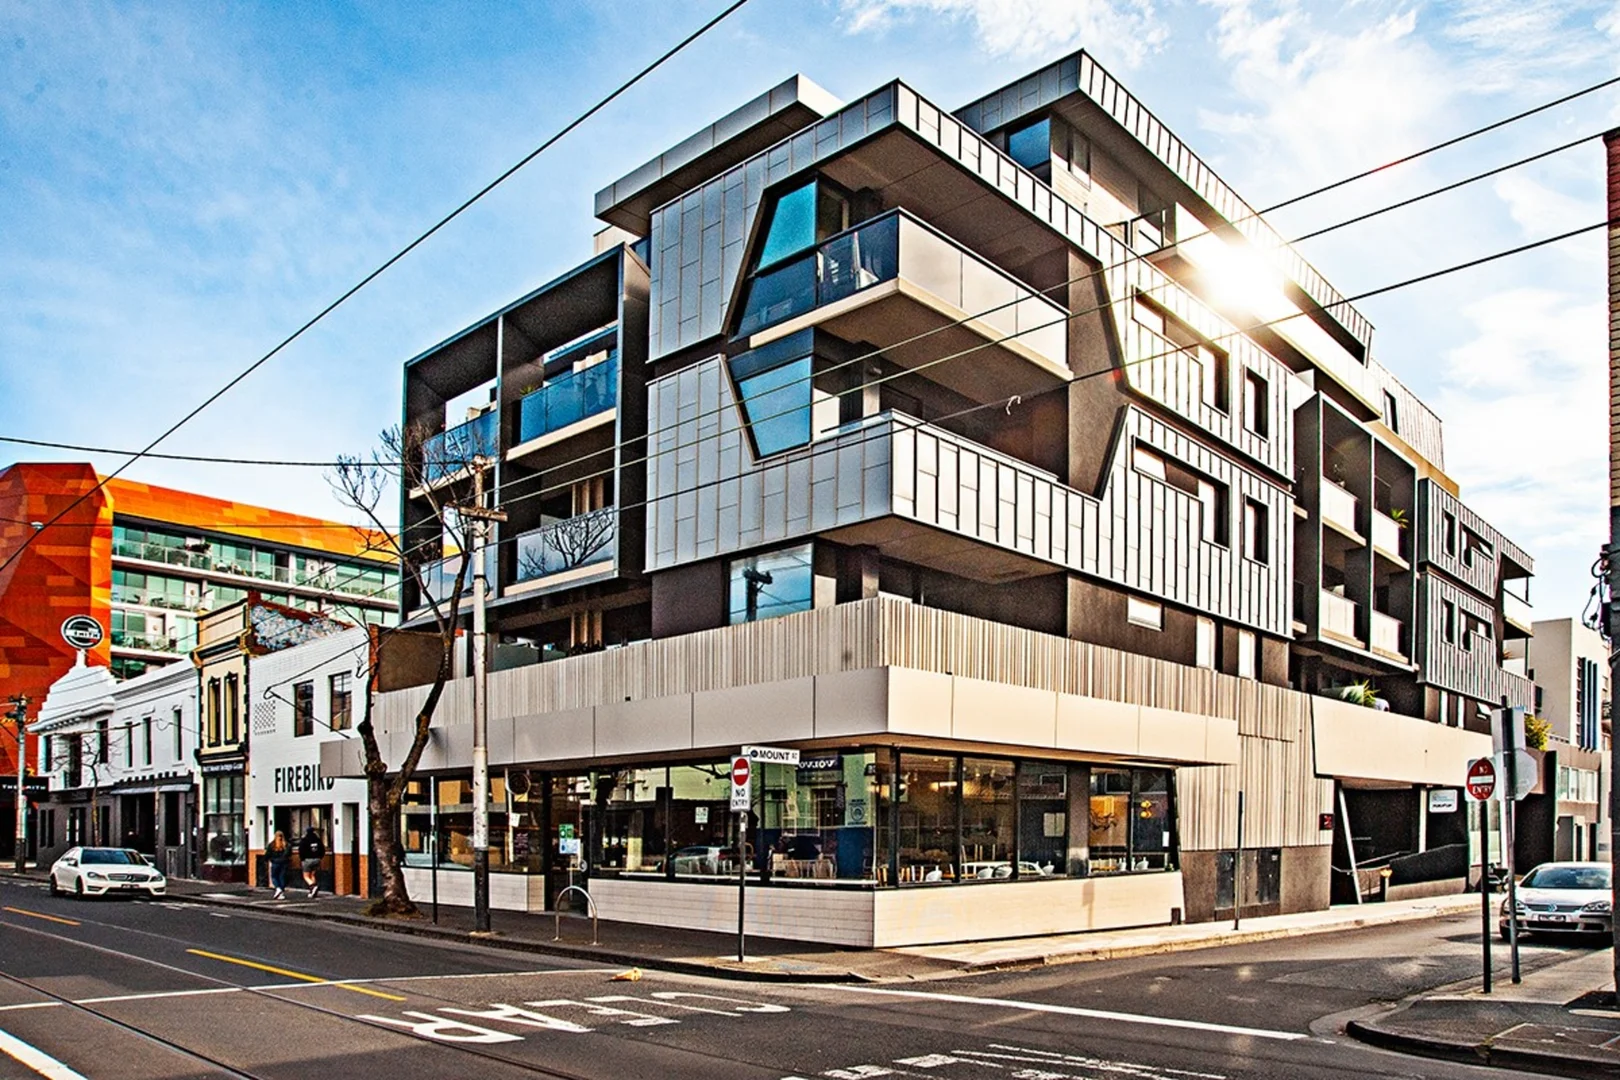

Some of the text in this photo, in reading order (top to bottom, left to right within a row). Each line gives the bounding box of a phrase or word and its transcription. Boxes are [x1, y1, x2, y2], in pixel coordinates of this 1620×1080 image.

[759, 749, 790, 761] MOUNT
[735, 788, 746, 797] NO
[355, 992, 789, 1043] CLEAR
